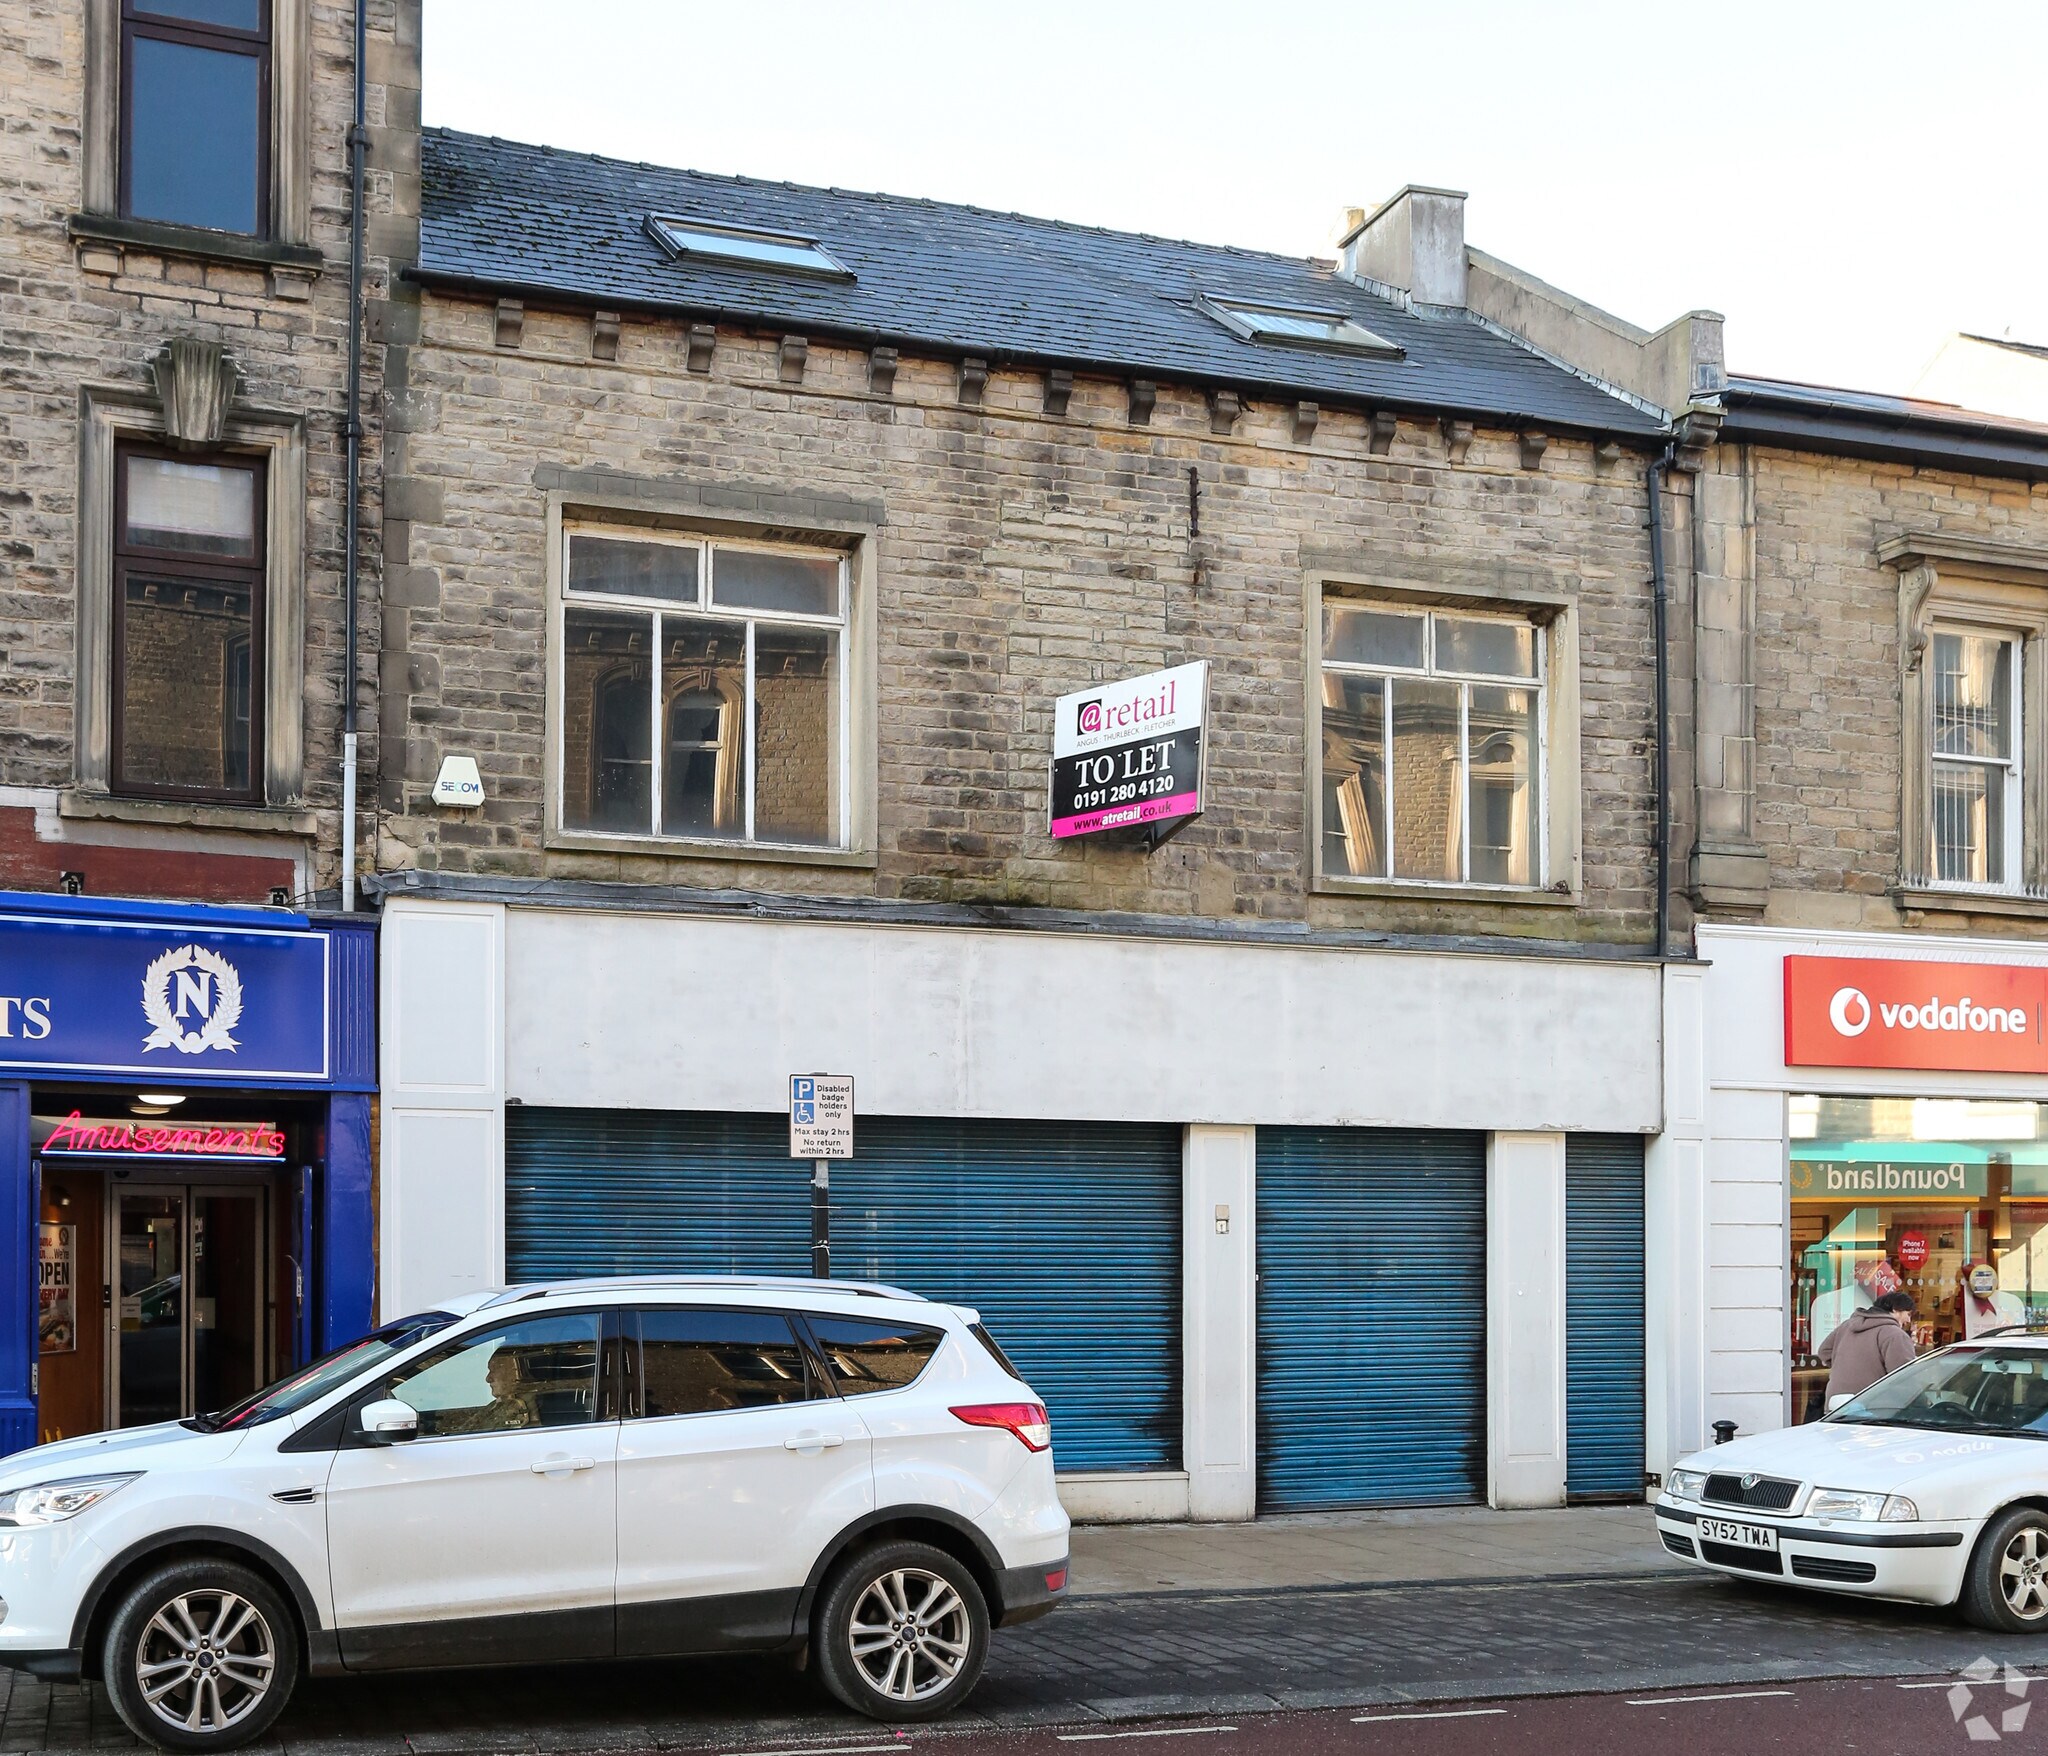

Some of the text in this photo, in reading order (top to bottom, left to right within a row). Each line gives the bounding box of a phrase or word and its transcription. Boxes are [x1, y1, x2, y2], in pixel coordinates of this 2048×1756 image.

[1079, 680, 1176, 734] @retail
[1076, 719, 1176, 748] ANGUS THURLBECK FLETCHER
[1075, 739, 1176, 788] TO LET
[441, 781, 479, 793] SECOM
[1073, 774, 1174, 810] 0191 280 4120
[1073, 801, 1172, 831] www.atretail.co.uk
[174, 971, 212, 1018] N
[0, 996, 52, 1039] TS
[1879, 996, 2027, 1033] vodafone
[819, 1102, 848, 1110] holders
[821, 1094, 845, 1102] badge
[825, 1111, 842, 1119] only
[42, 1110, 286, 1156] Amusements
[813, 1128, 829, 1136] stay
[837, 1128, 850, 1136] hrs
[39, 1288, 56, 1300] VERY
[1702, 1520, 1771, 1547] SY52 TWA
